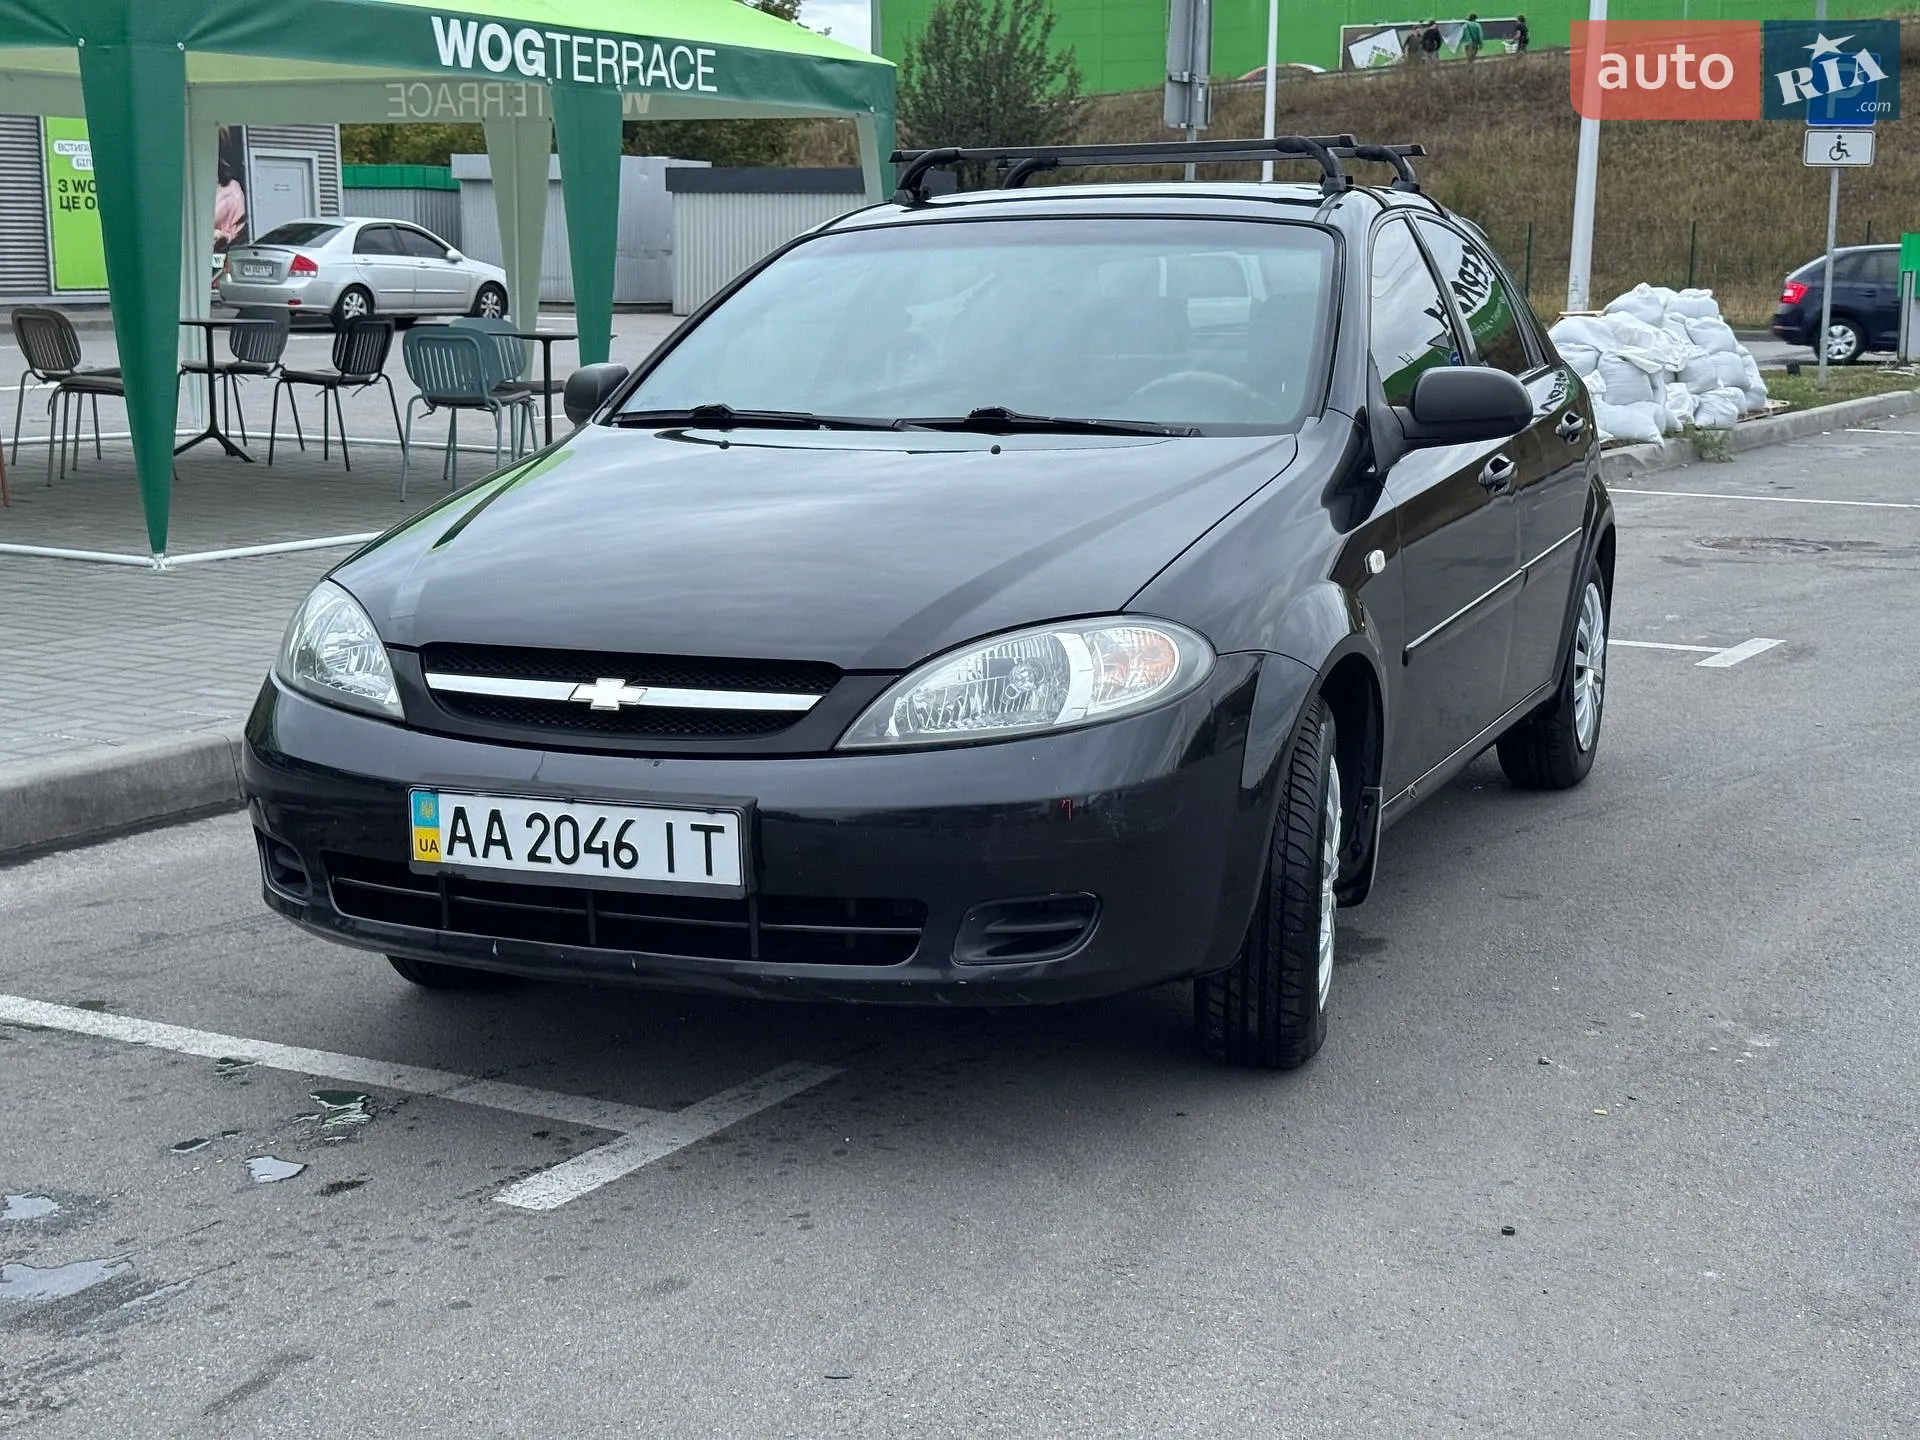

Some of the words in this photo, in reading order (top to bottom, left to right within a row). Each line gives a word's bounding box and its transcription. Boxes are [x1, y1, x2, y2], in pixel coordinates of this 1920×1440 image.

[72, 179, 98, 193] WO
[59, 195, 81, 213] ЦЕ
[419, 838, 440, 854] UA
[446, 806, 513, 861] AA
[525, 812, 639, 870] 2046
[665, 821, 725, 876] IT
